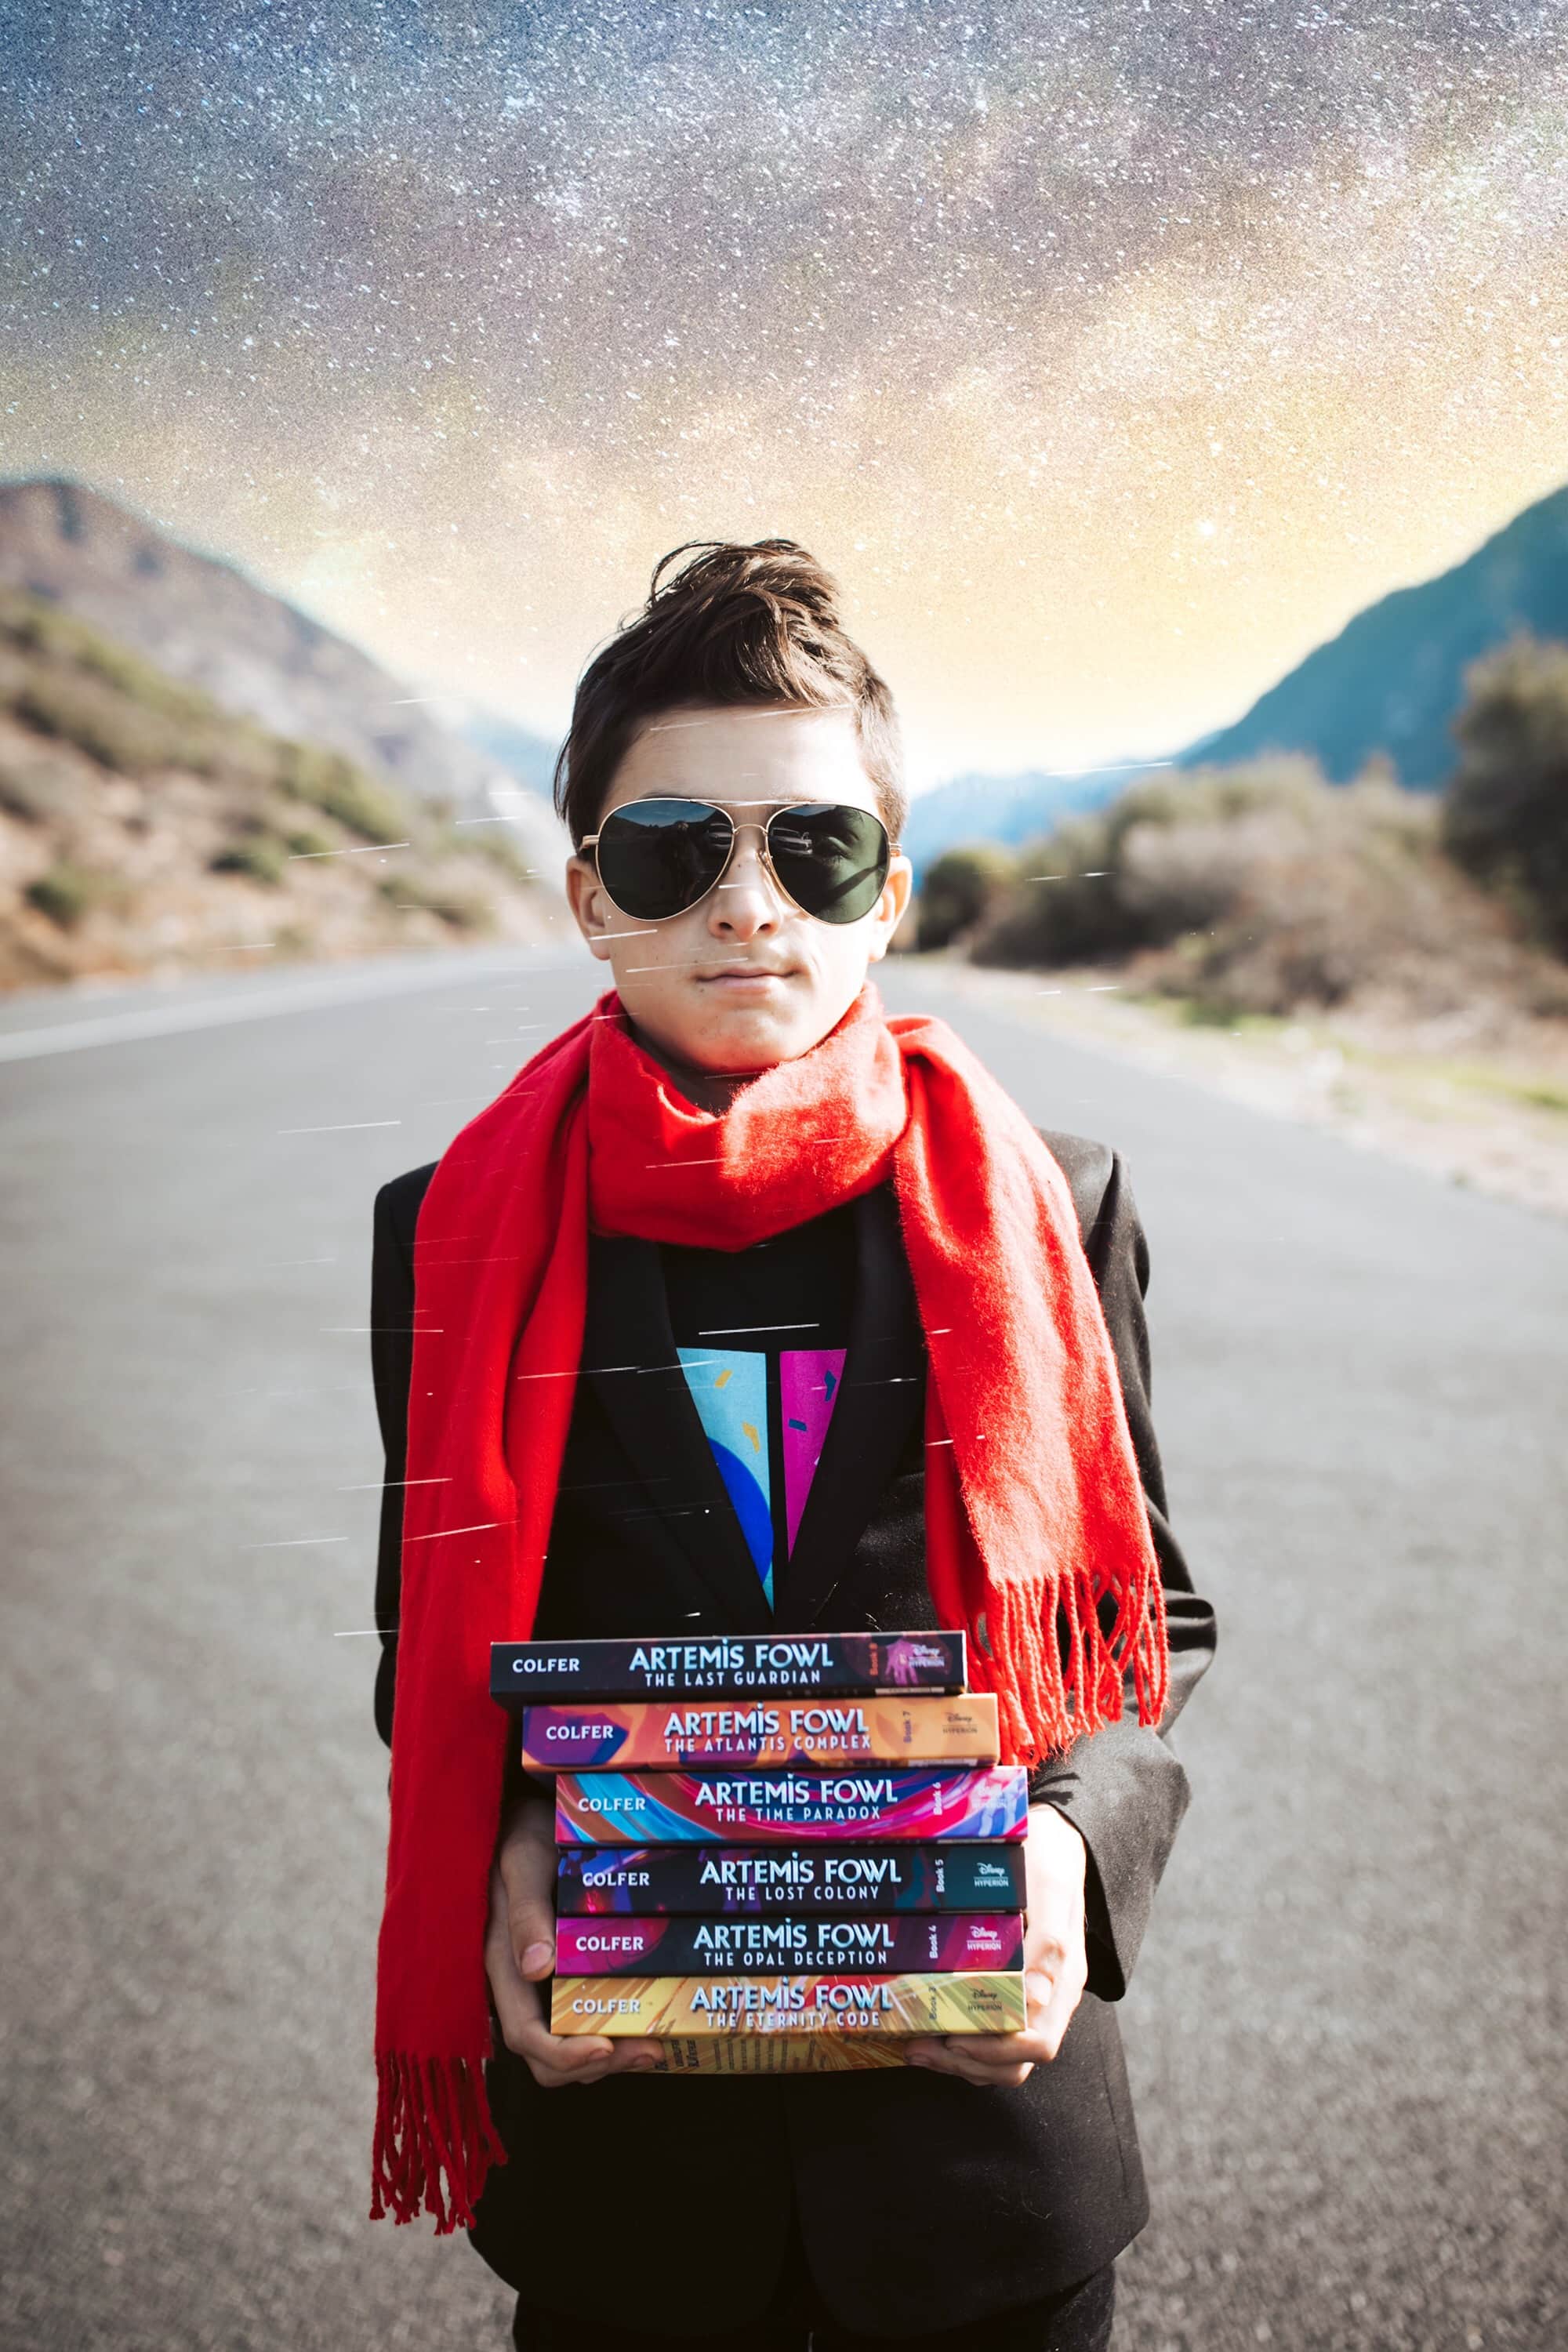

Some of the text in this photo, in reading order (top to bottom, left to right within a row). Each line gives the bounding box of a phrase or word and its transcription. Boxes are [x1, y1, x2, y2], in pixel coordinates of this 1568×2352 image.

[756, 1643, 833, 1668] FOWL
[513, 1658, 579, 1673] COLFER
[645, 1670, 820, 1687] THE LAST GUARDIAN
[790, 1708, 869, 1733] FOWL
[546, 1726, 613, 1740] COLFER
[665, 1735, 871, 1752] THE ATLANTIS COMPLEX
[821, 1779, 898, 1803] FOWL
[578, 1797, 646, 1811] COLFER
[716, 1806, 880, 1822] THE TIME PARADOX
[825, 1859, 902, 1883] FOWL
[976, 1863, 1005, 1876] Disney
[583, 1872, 650, 1886] COLFER
[935, 1868, 945, 1893] Book
[975, 1878, 1008, 1887] HYPERION
[726, 1886, 879, 1900] THE LOST COLONY
[818, 1924, 894, 1948] FOWL
[970, 1926, 997, 1940] Disney
[576, 1936, 644, 1951] COLFER
[929, 1934, 938, 1958] Book
[967, 1942, 1001, 1951] HYPERION
[704, 1951, 887, 1966] THE OPAL DECEPTION
[815, 1982, 894, 2009] FOWL
[572, 1998, 640, 2013] COLFER
[706, 2010, 880, 2027] THE ETERNITY CODE
